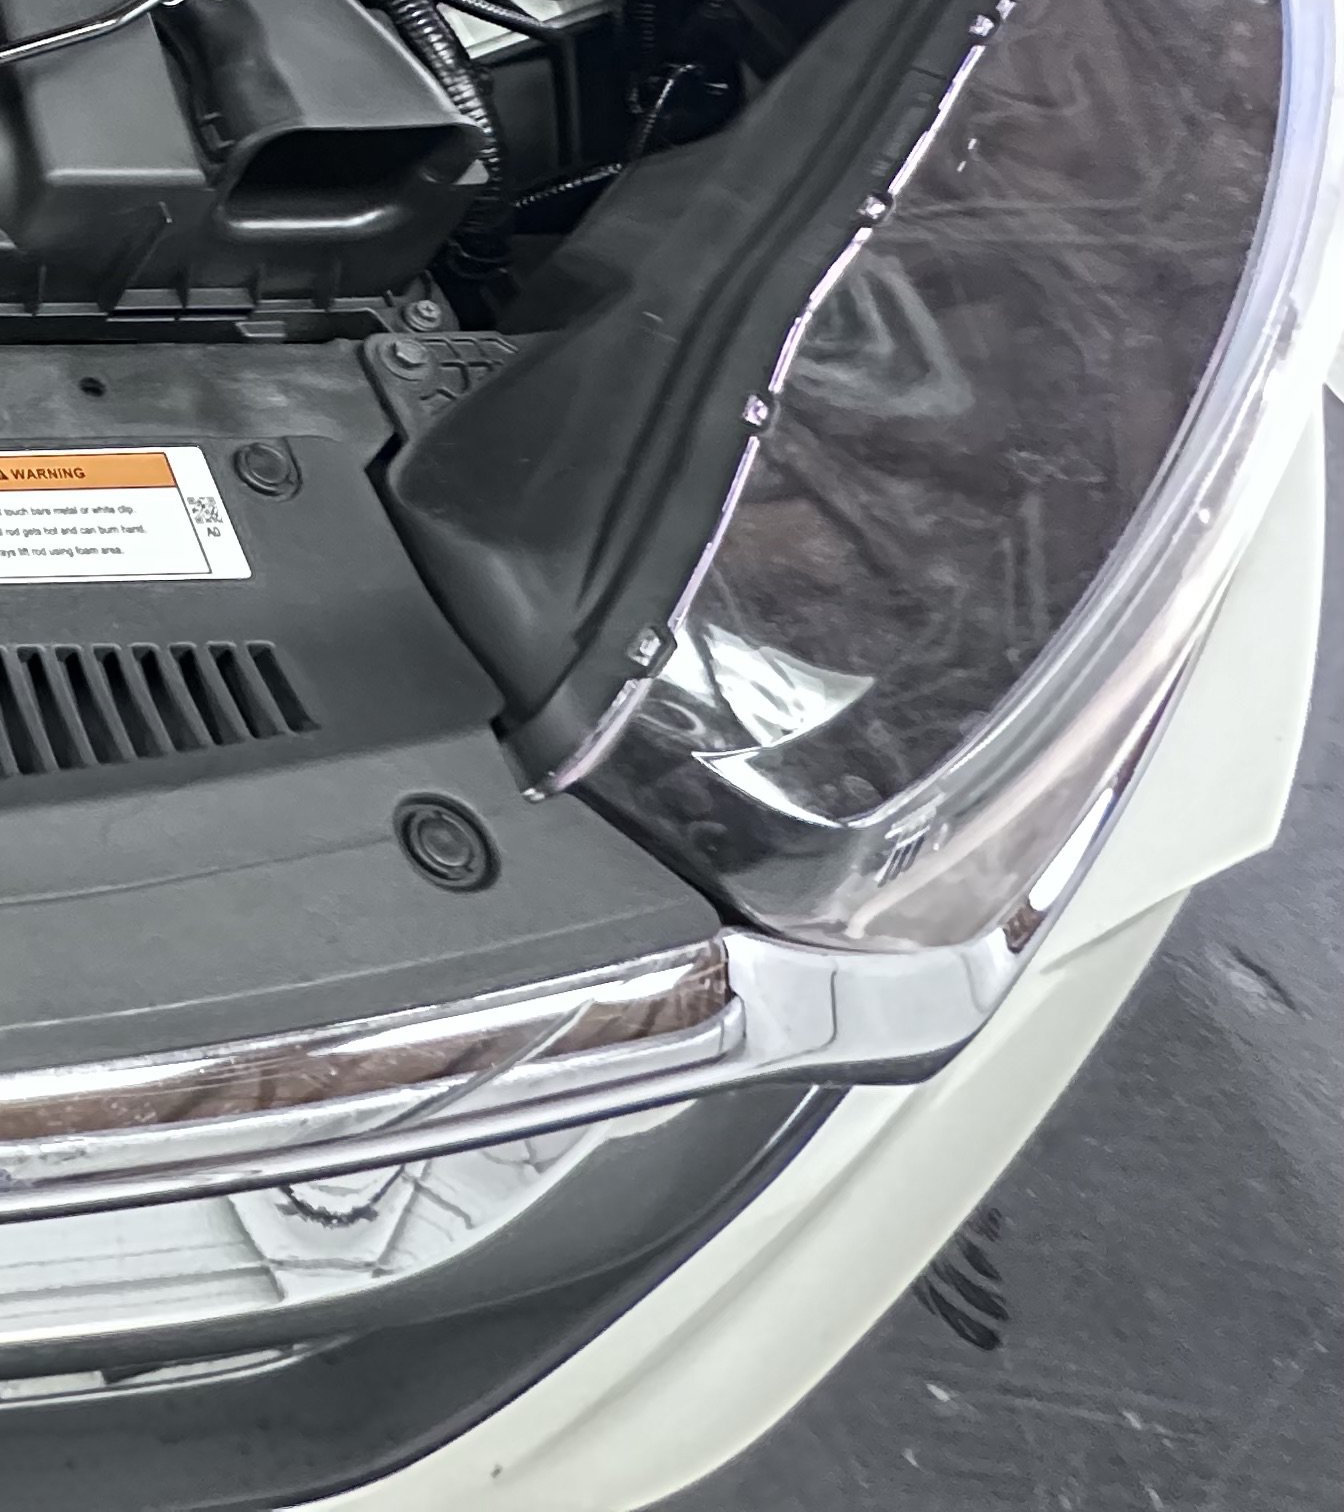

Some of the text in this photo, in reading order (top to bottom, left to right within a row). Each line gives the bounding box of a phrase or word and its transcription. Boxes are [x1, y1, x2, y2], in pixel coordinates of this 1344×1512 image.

[10, 467, 86, 480] WARNING
[3, 507, 28, 516] touch
[30, 506, 51, 516] bare
[53, 506, 78, 515] metal
[79, 507, 89, 515] or
[92, 506, 115, 514] white
[5, 527, 20, 536] rod
[22, 527, 42, 538] gets
[43, 526, 58, 536] hot
[60, 526, 78, 535] and
[79, 527, 96, 535] can
[97, 525, 119, 535] burn
[17, 547, 30, 556] lift
[31, 547, 47, 556] rod
[49, 547, 74, 558] using
[75, 545, 99, 555] foam
